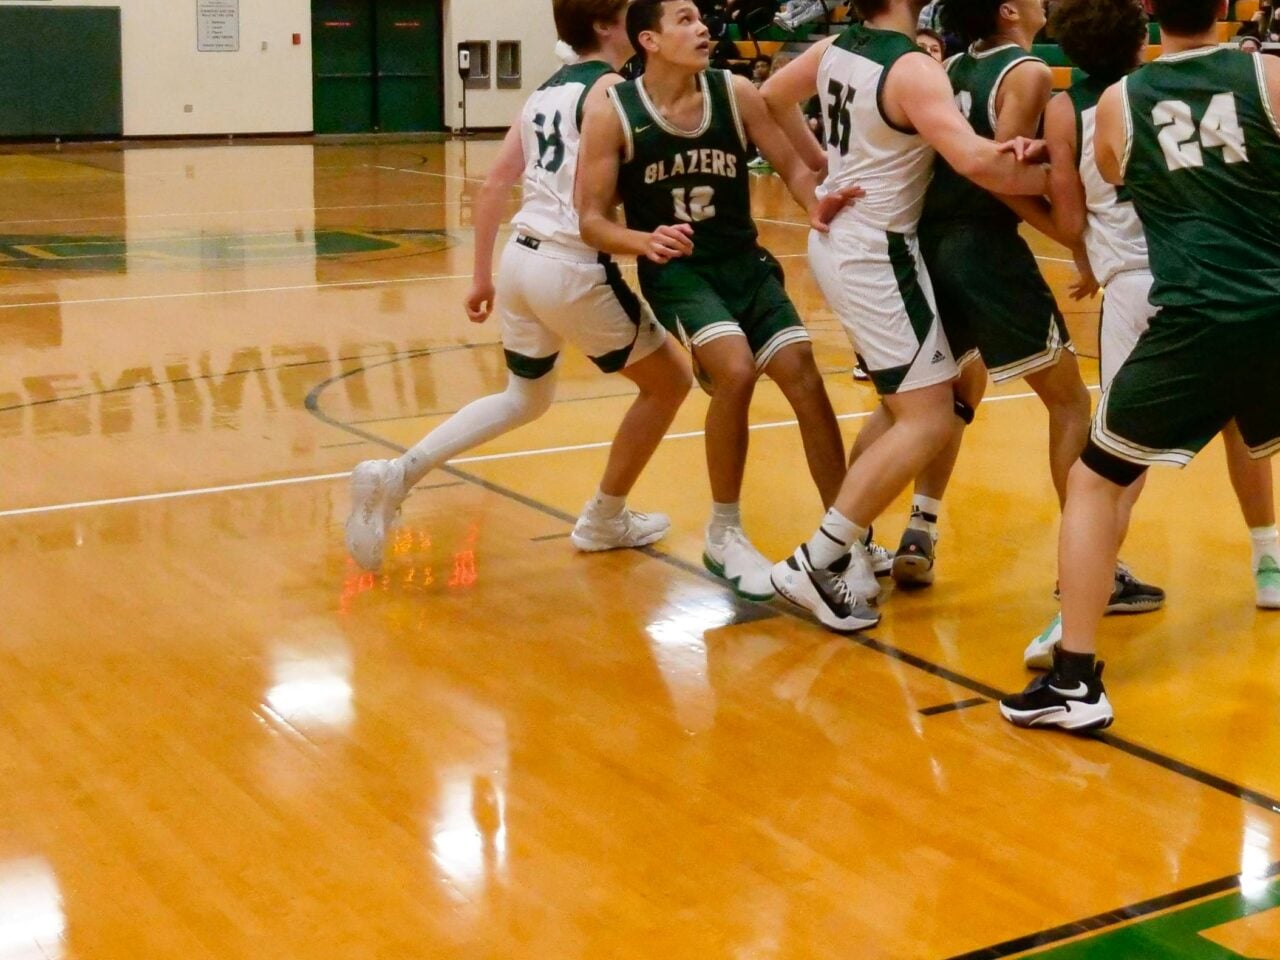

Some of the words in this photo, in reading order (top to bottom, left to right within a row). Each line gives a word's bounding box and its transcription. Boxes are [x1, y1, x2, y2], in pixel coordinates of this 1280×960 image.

[1151, 91, 1249, 172] 24
[644, 148, 738, 184] BLAZERS
[671, 185, 716, 222] 12
